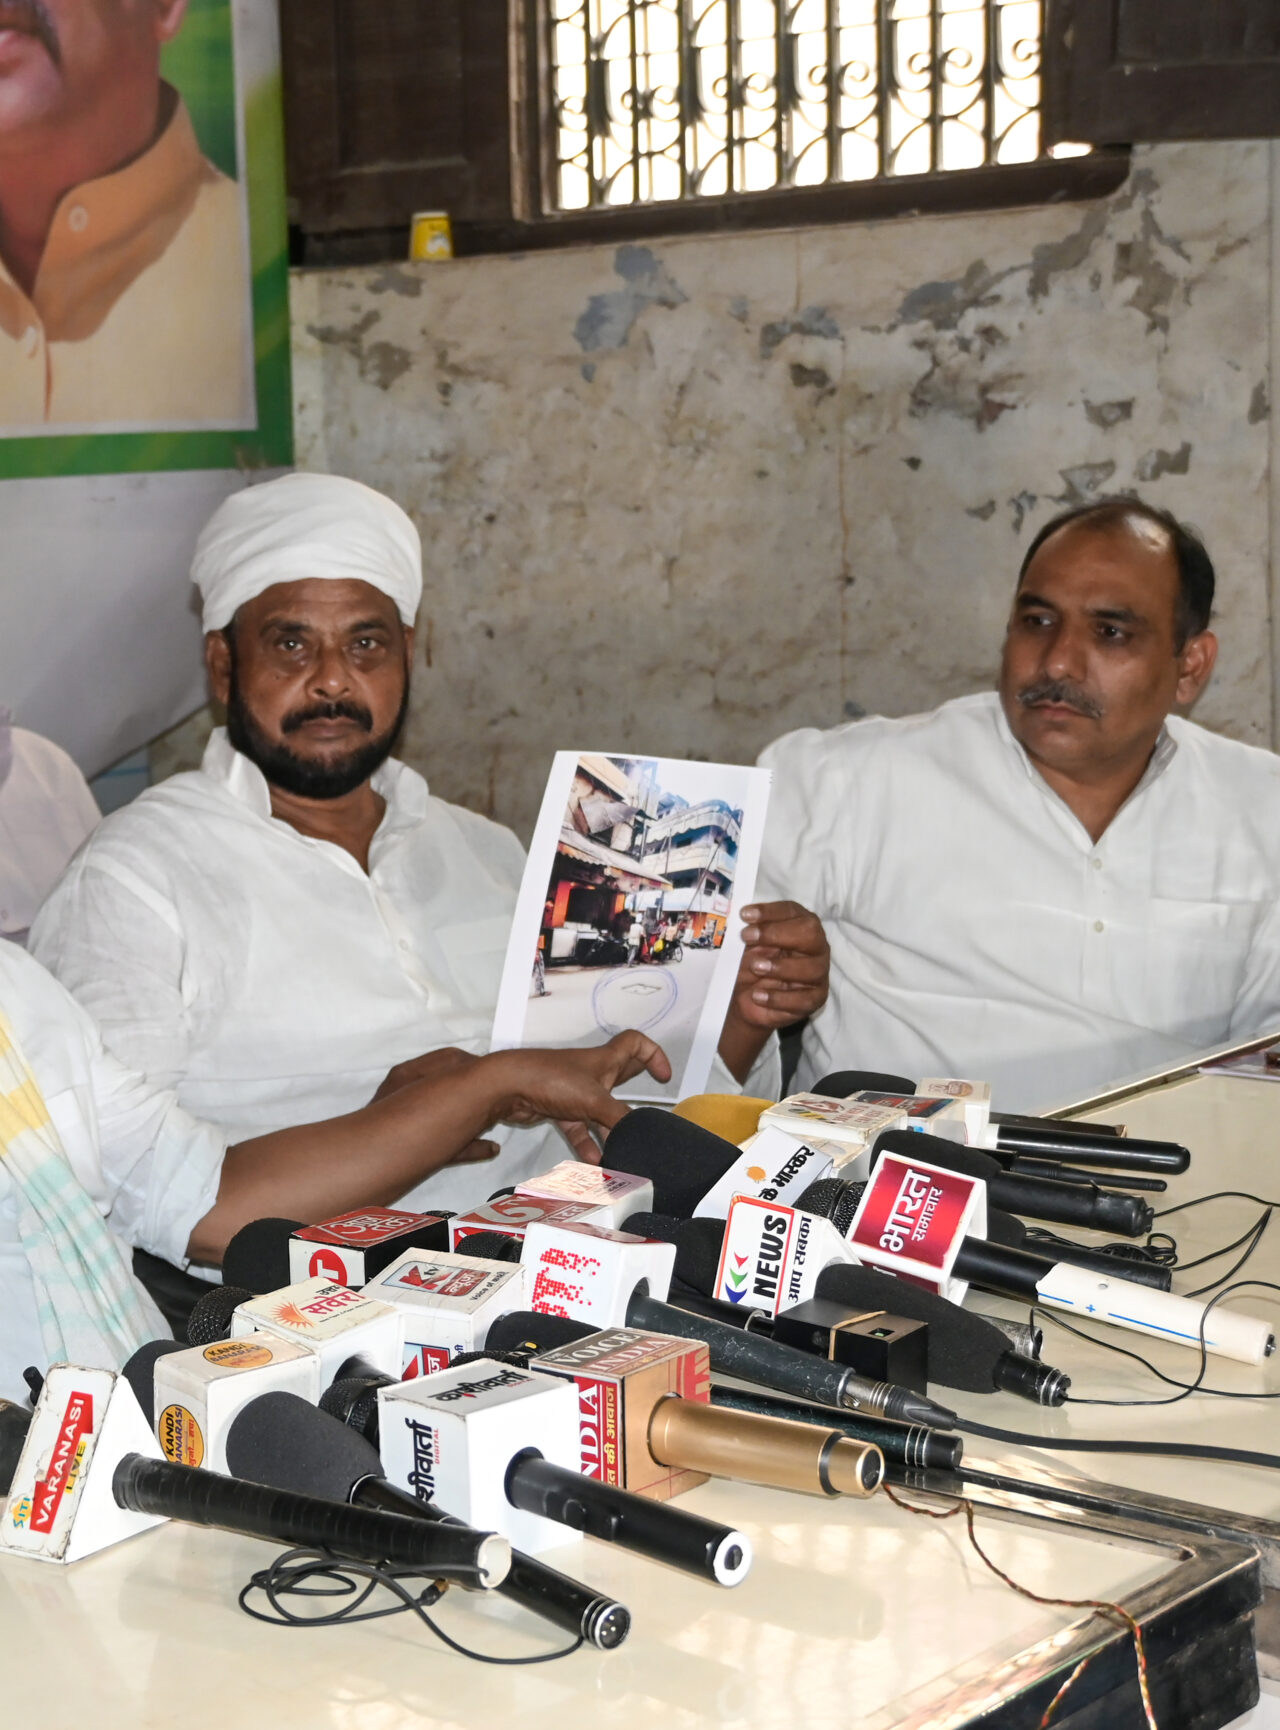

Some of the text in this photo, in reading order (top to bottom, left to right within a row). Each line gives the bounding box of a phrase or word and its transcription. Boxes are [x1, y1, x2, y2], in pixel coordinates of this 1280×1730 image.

[770, 1145, 815, 1188] भास्कर
[368, 1216, 414, 1232] तक
[879, 1167, 931, 1252] भारत
[911, 1186, 943, 1242] समाचार
[753, 1214, 787, 1299] NEWS
[788, 1215, 812, 1303] आप सबका
[300, 1290, 367, 1316] सवेरा
[552, 1332, 642, 1364] VOICE
[588, 1338, 671, 1371] INDIA
[166, 1412, 175, 1457] KANDI
[175, 1406, 183, 1464] ANARASI
[433, 1428, 441, 1465] DIGITAL
[579, 1383, 600, 1477] NDIA
[604, 1441, 616, 1465] की
[36, 1398, 85, 1526] VARANASI
[66, 1444, 87, 1491] LIVE
[404, 1417, 436, 1503] शीवार्ता
[13, 1496, 31, 1529] SITI
